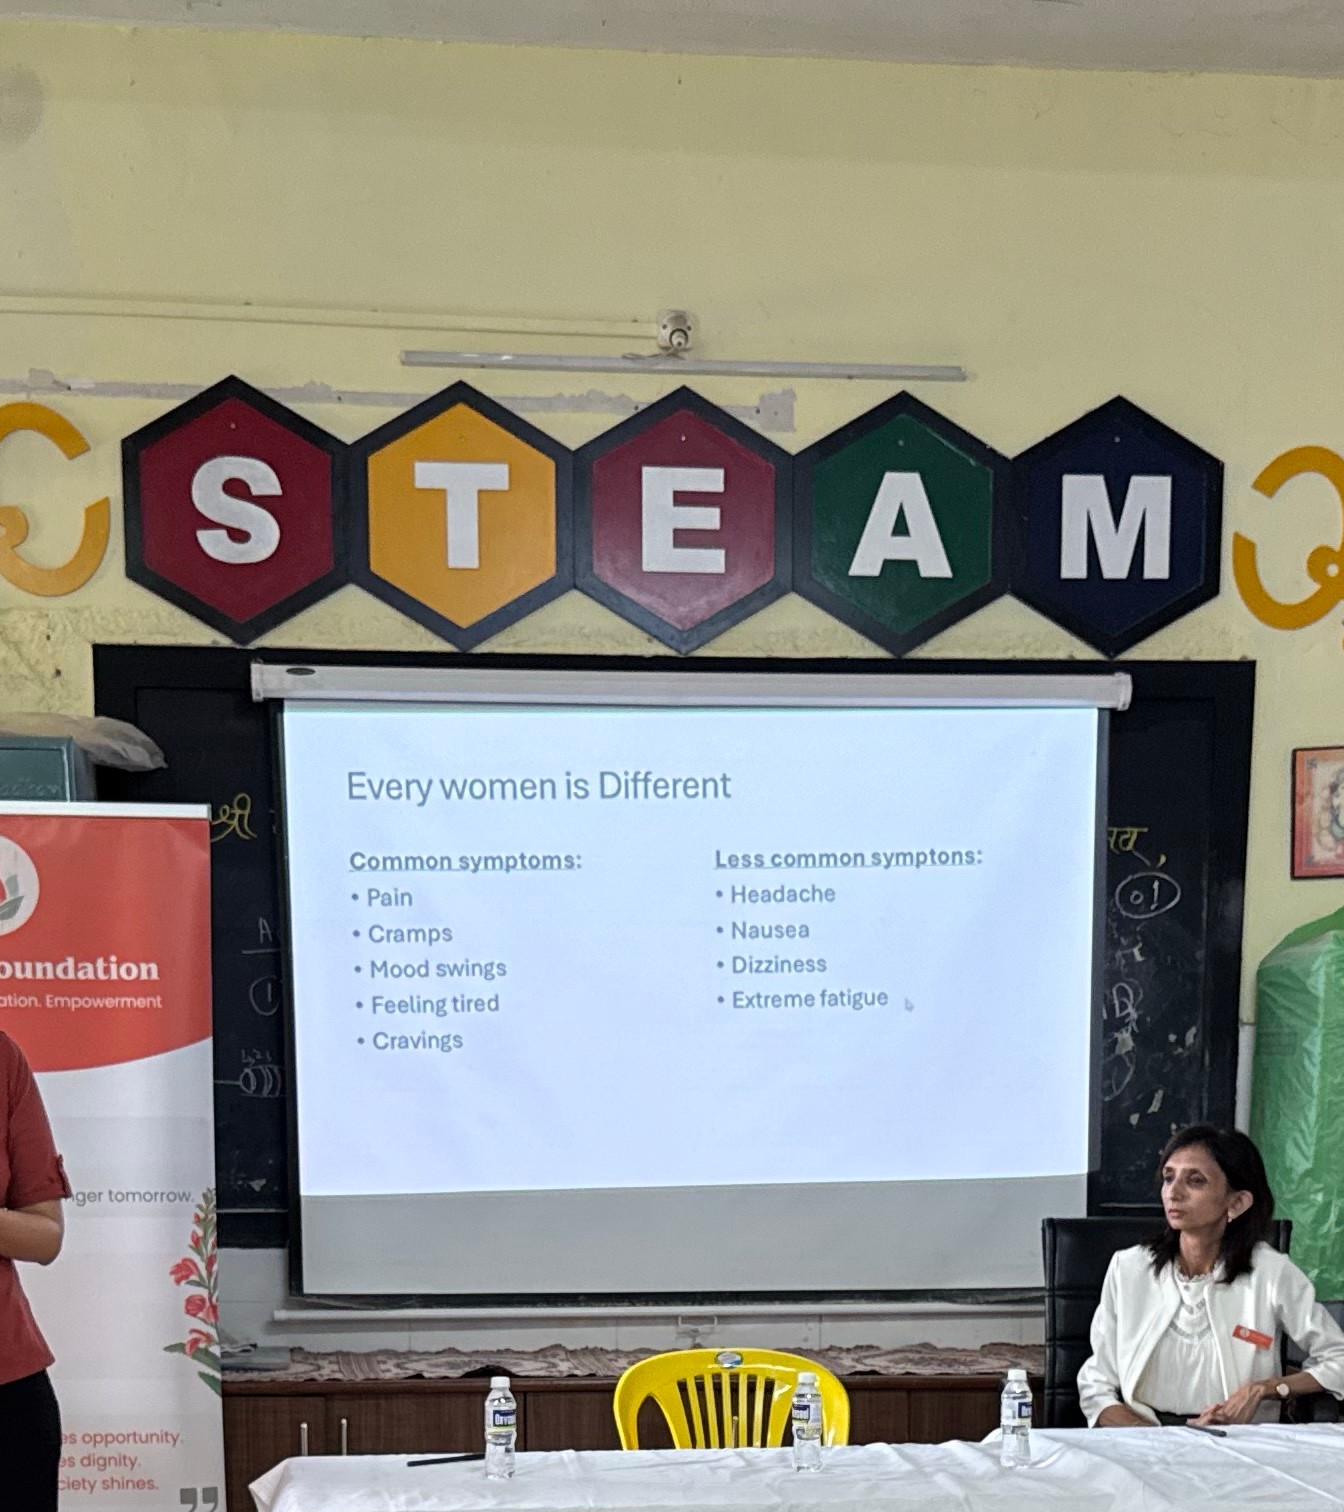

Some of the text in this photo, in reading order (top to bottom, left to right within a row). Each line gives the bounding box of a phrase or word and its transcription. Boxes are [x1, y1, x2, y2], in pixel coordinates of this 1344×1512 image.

[191, 455, 1173, 580] STEAM
[348, 770, 731, 807] Every women is Different
[349, 852, 582, 873] Common symptoms:
[715, 848, 983, 870] Less common symptons:
[367, 888, 413, 907] Pain
[731, 884, 836, 904] Headache
[368, 925, 453, 946] Cramps
[731, 922, 810, 939] Nausea
[370, 959, 507, 981] Mood swings
[732, 955, 827, 974] Dizziness
[46, 994, 163, 1012] Empowerment
[372, 994, 500, 1017] Feeling tired
[732, 988, 889, 1010] Extreme fatigue
[373, 1030, 464, 1053] Cravings
[108, 1189, 194, 1203] tomorrow.
[81, 1430, 183, 1448] opportunity.
[80, 1453, 142, 1472] dignity.
[57, 1476, 159, 1494] ciety shines.
